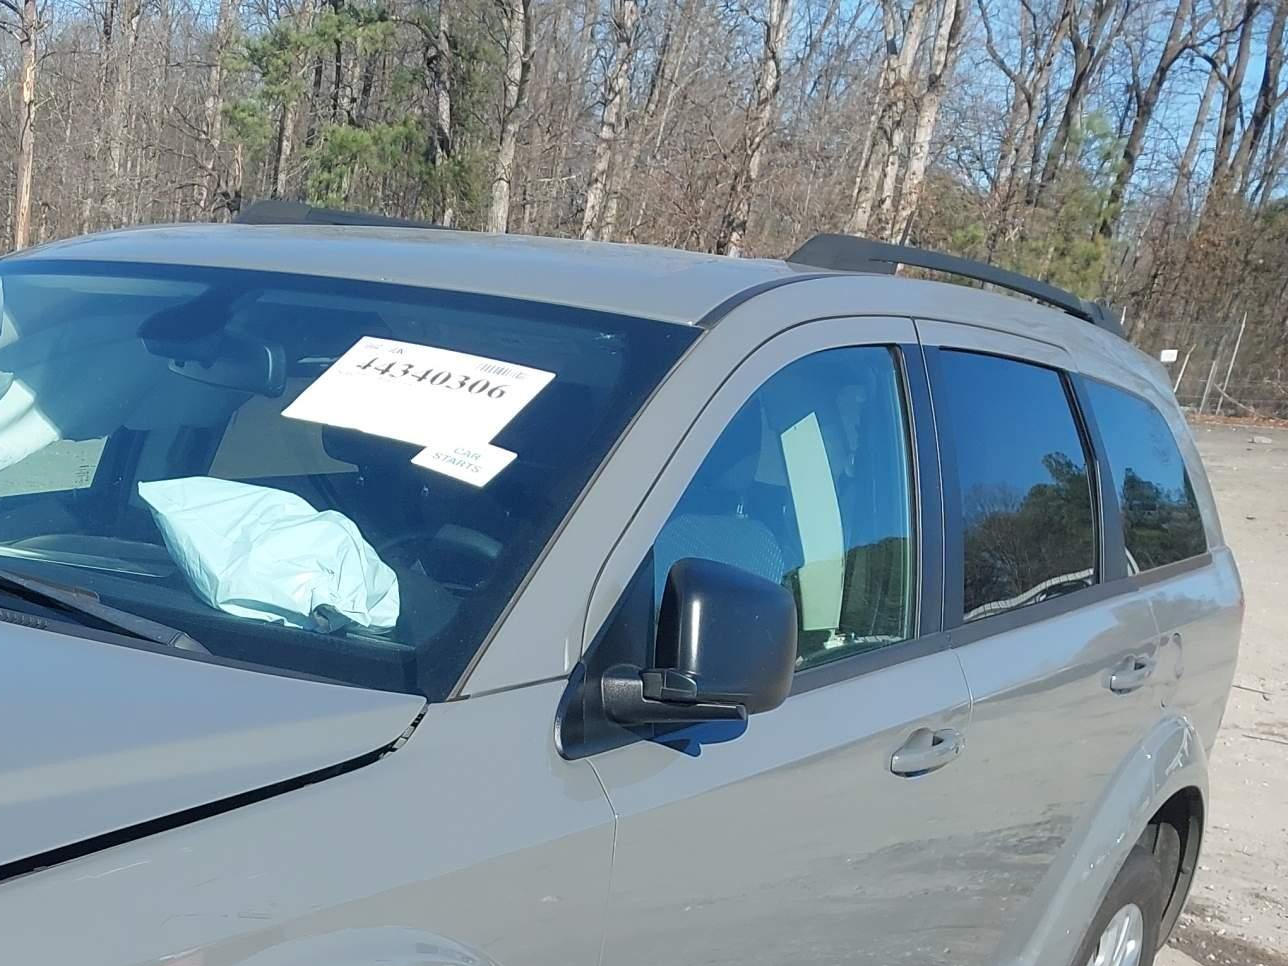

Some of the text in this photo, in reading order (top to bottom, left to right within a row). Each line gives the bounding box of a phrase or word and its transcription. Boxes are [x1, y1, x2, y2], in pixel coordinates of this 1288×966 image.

[357, 357, 508, 400] 44340306
[432, 451, 483, 474] STARTS
[453, 447, 482, 461] CAR
